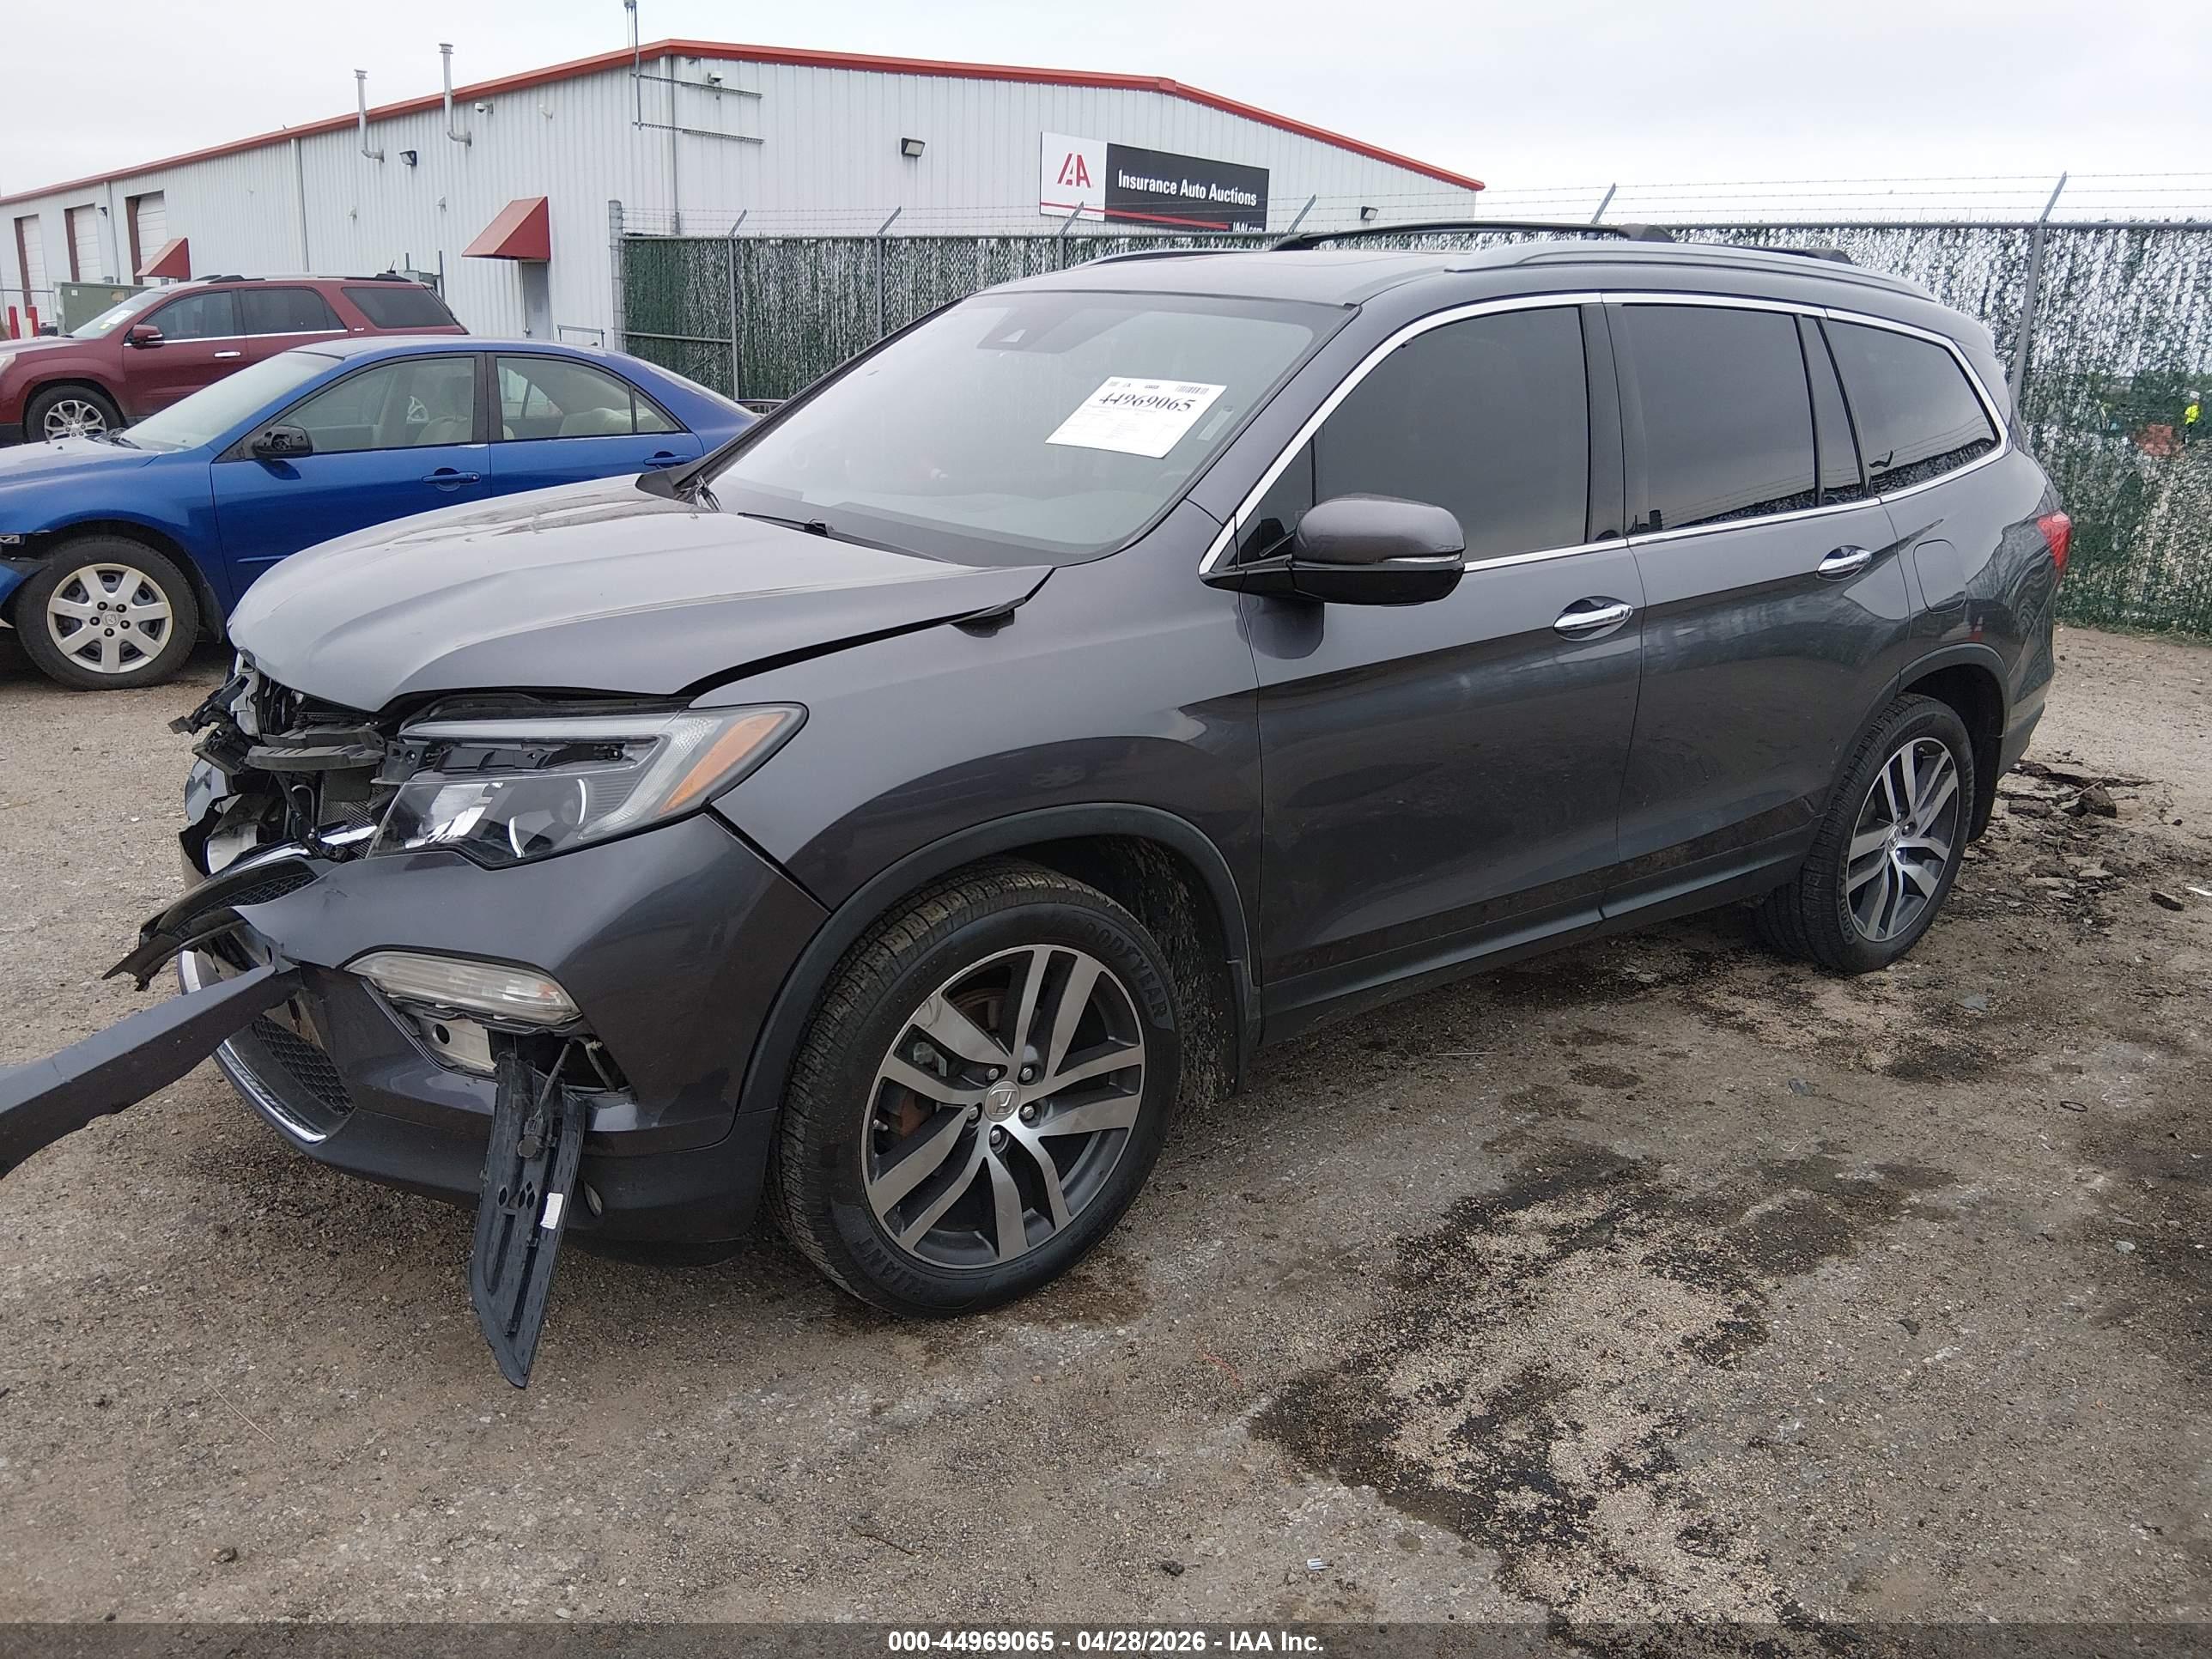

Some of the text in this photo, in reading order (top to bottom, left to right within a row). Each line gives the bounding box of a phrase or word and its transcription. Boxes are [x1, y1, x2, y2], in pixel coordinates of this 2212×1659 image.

[1117, 168, 1257, 207] Insurance Auto Auctions
[1099, 392, 1197, 412] 44969065
[1075, 920, 1167, 1018] OODYEAR
